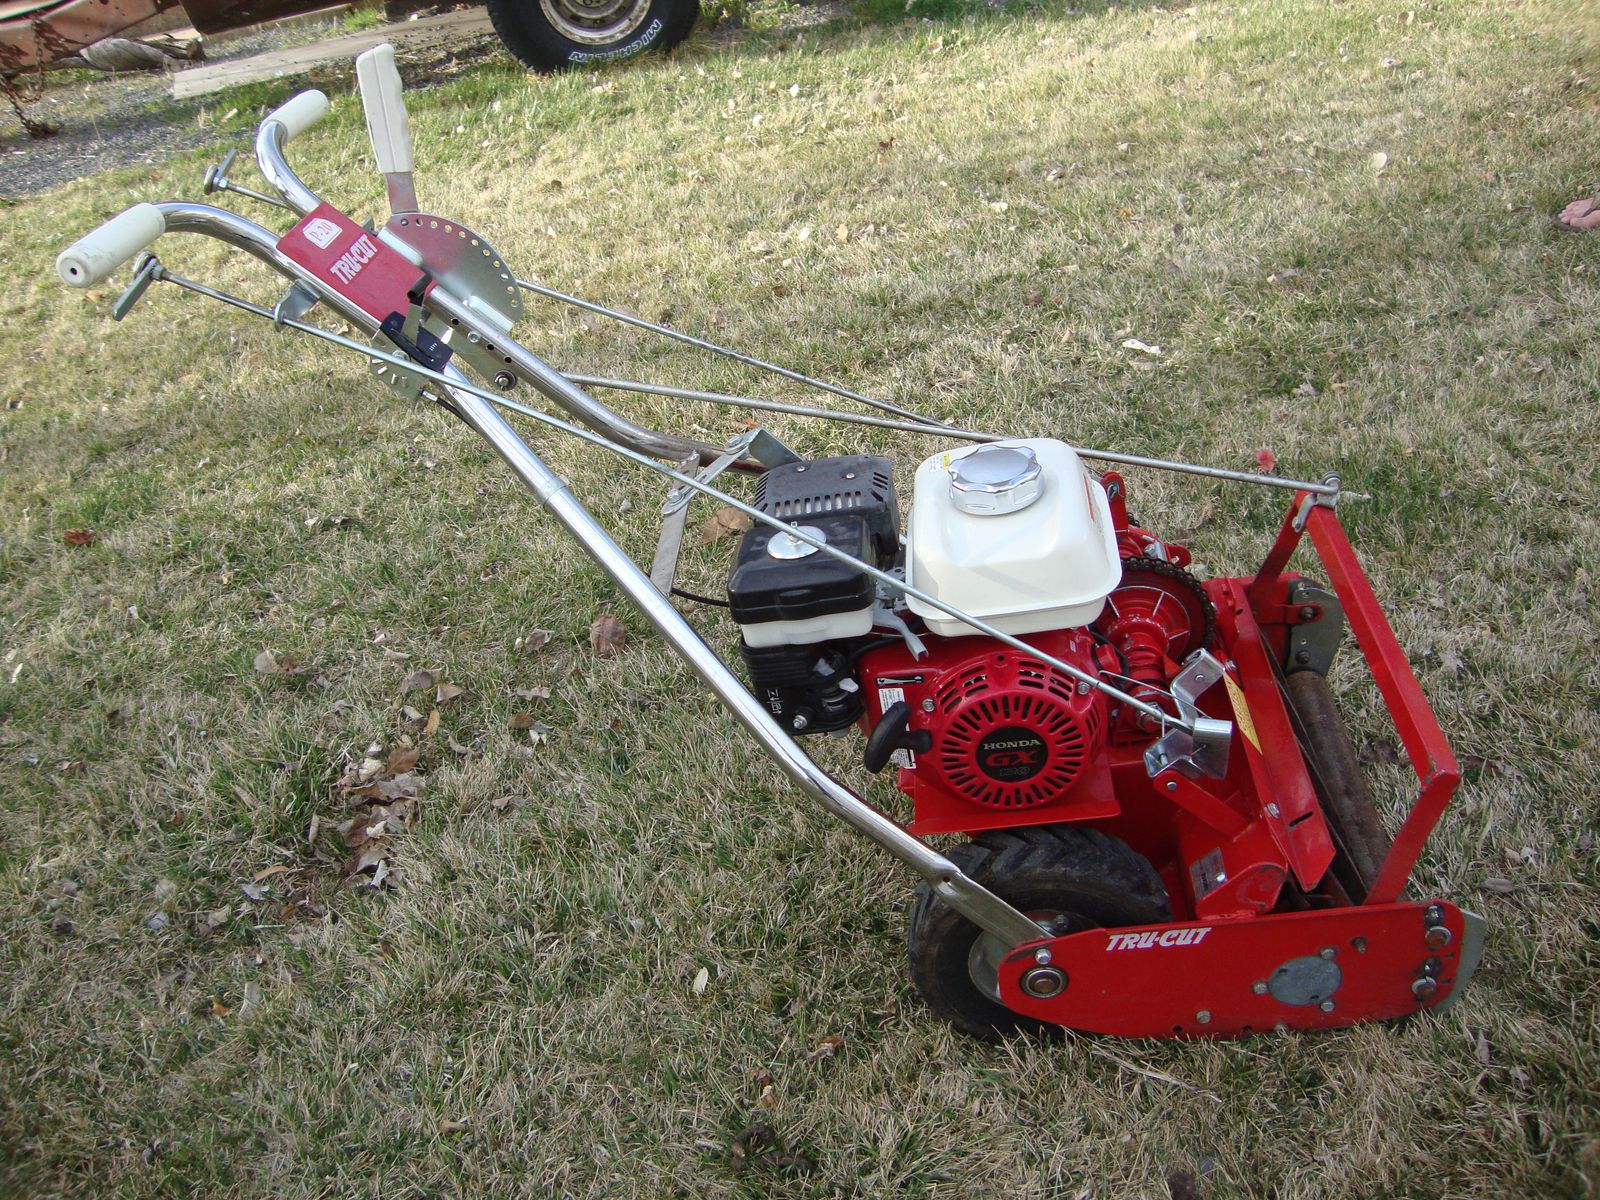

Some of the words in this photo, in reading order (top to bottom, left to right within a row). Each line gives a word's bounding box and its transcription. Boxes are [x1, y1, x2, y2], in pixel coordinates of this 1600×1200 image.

[329, 233, 378, 285] TRU-CUT
[983, 739, 1041, 750] HONDA
[985, 749, 1040, 767] GX
[1105, 926, 1213, 952] TRU-CUT
